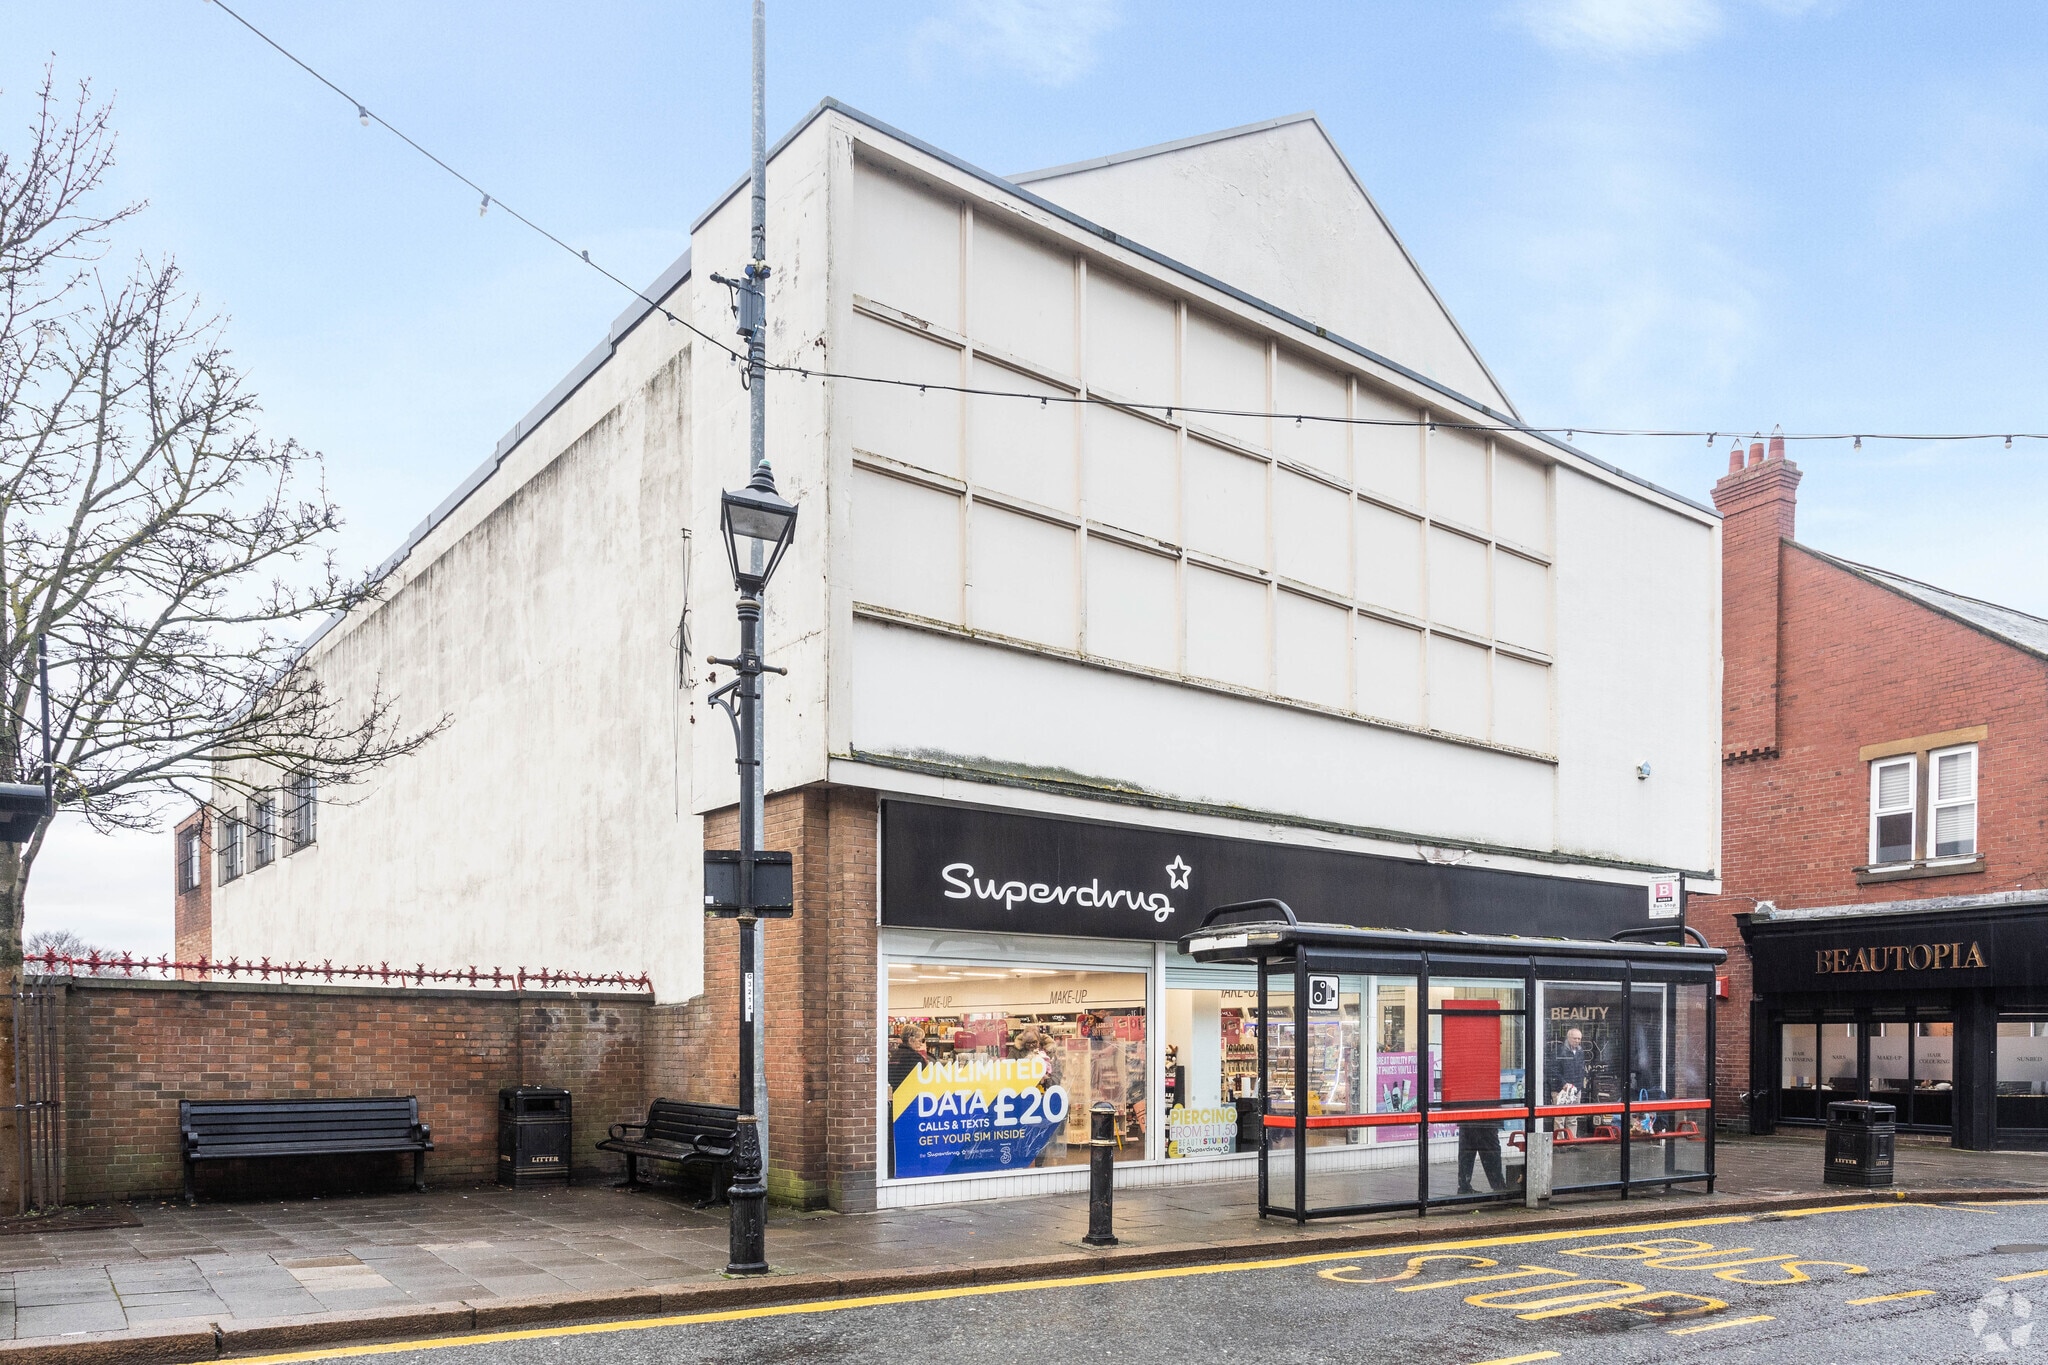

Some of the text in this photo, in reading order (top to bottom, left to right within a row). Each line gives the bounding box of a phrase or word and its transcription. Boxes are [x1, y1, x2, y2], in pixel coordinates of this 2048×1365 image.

[941, 862, 1175, 923] Superdrug
[1815, 941, 1989, 974] BEAUTOPIA
[923, 996, 953, 1009] MAKE-UP
[1049, 990, 1088, 1004] MAKE-UP
[1551, 1006, 1609, 1020] BEAUTY
[917, 1058, 1047, 1084] UNLIMITED
[918, 1085, 1069, 1127] DATA £20
[1170, 1107, 1237, 1125] PIERCING
[919, 1118, 990, 1132] CALLS & TEXTS
[1171, 1123, 1237, 1139] FROM £11.50
[919, 1129, 1026, 1146] GET YOUR SIM INSIDE
[1179, 1137, 1229, 1147] BEAUTY STUDIO
[927, 1150, 960, 1158] Superdrug
[1834, 1157, 1857, 1165] LITTER
[1557, 1238, 1870, 1286] BUS
[1316, 1253, 1730, 1321] STOP
